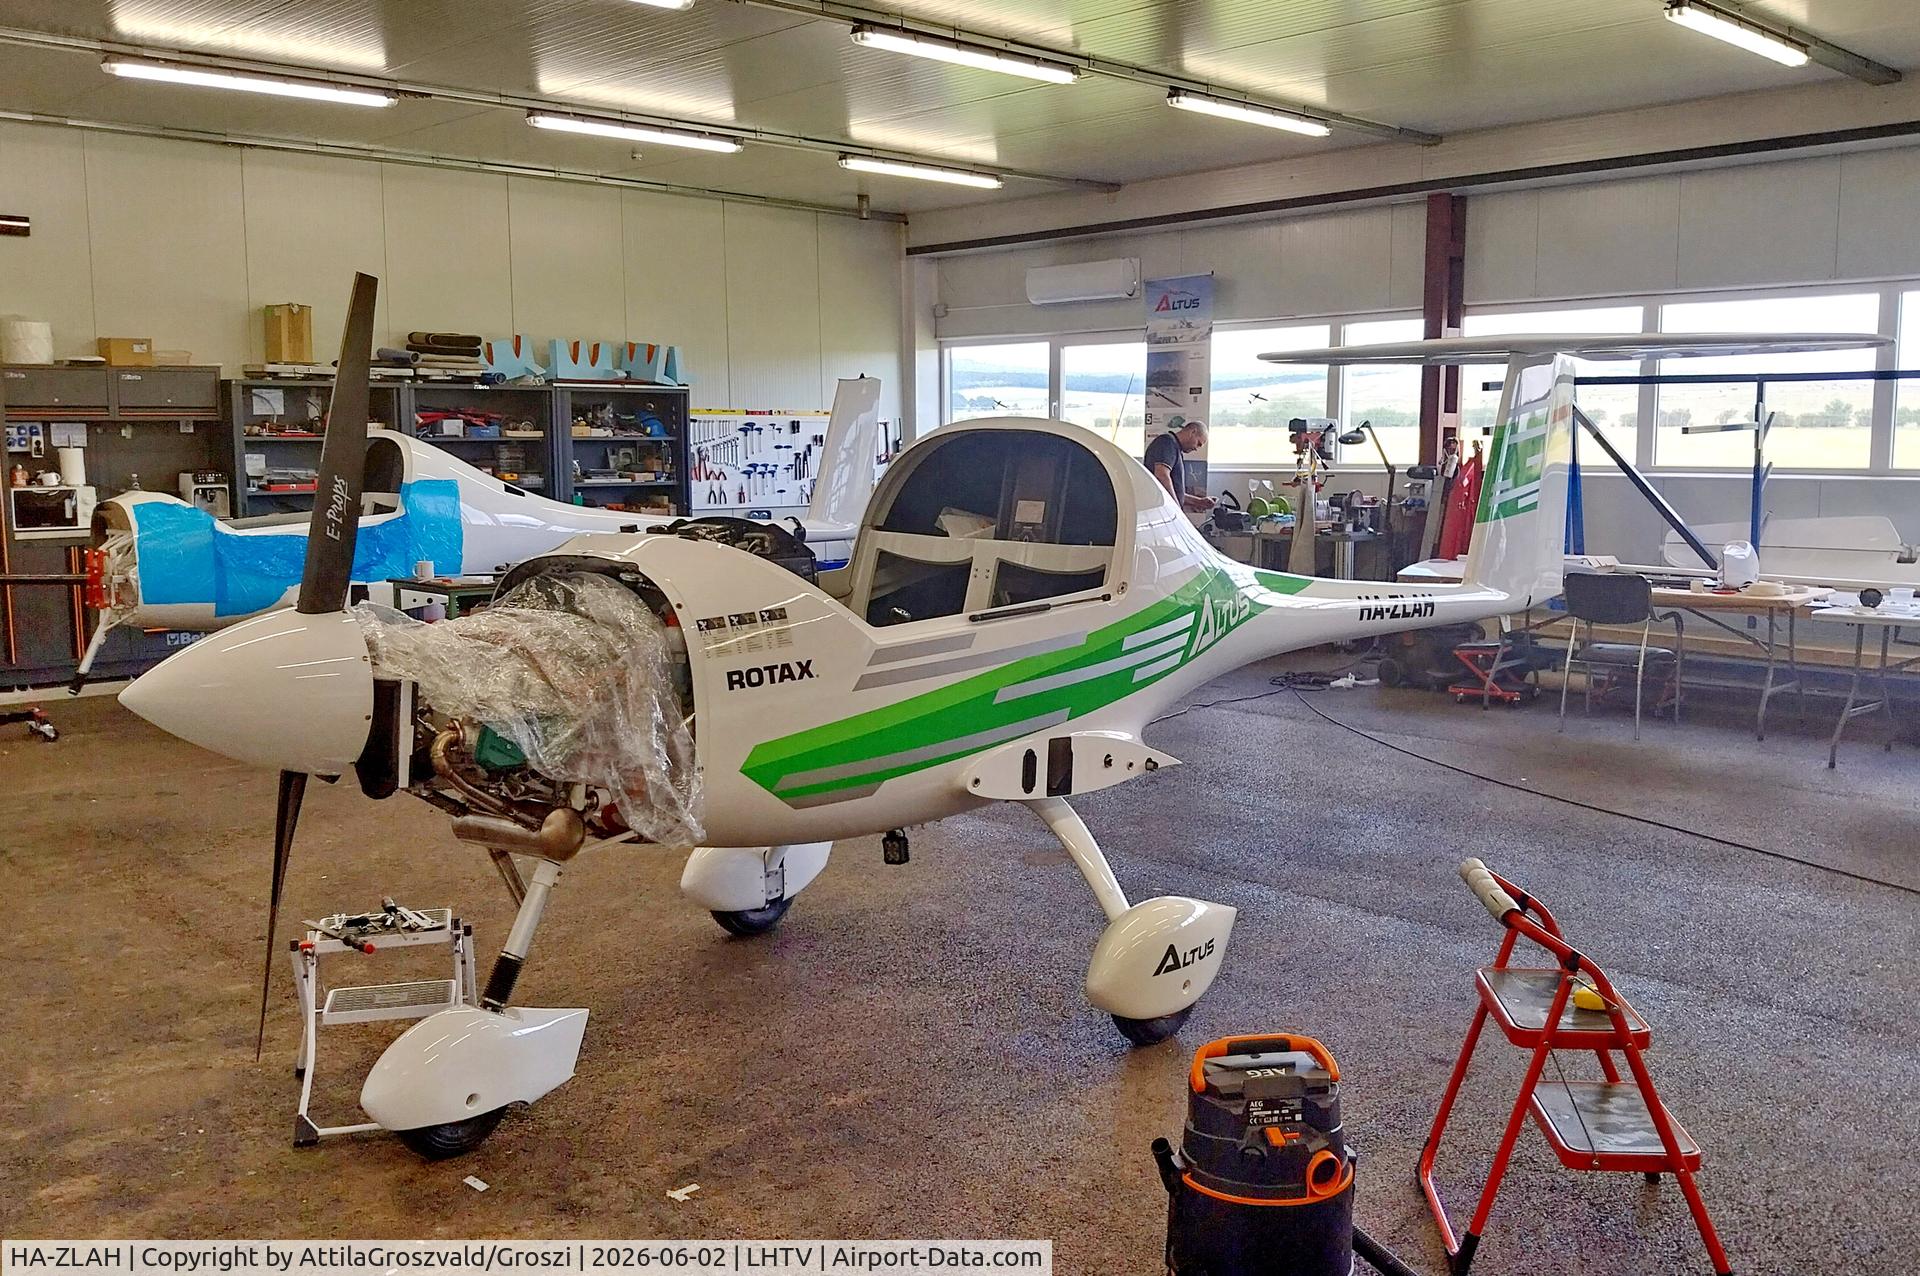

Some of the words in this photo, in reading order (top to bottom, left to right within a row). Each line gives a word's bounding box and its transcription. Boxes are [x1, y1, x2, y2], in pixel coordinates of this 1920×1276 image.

[1154, 294, 1200, 312] ALTUS
[326, 475, 352, 541] E-Props
[1357, 593, 1435, 621] HA-ZLAH
[726, 659, 815, 691] ROTAX
[1152, 937, 1215, 977] ALTUS
[1245, 1067, 1286, 1079] AEG
[1250, 1100, 1264, 1108] AEG
